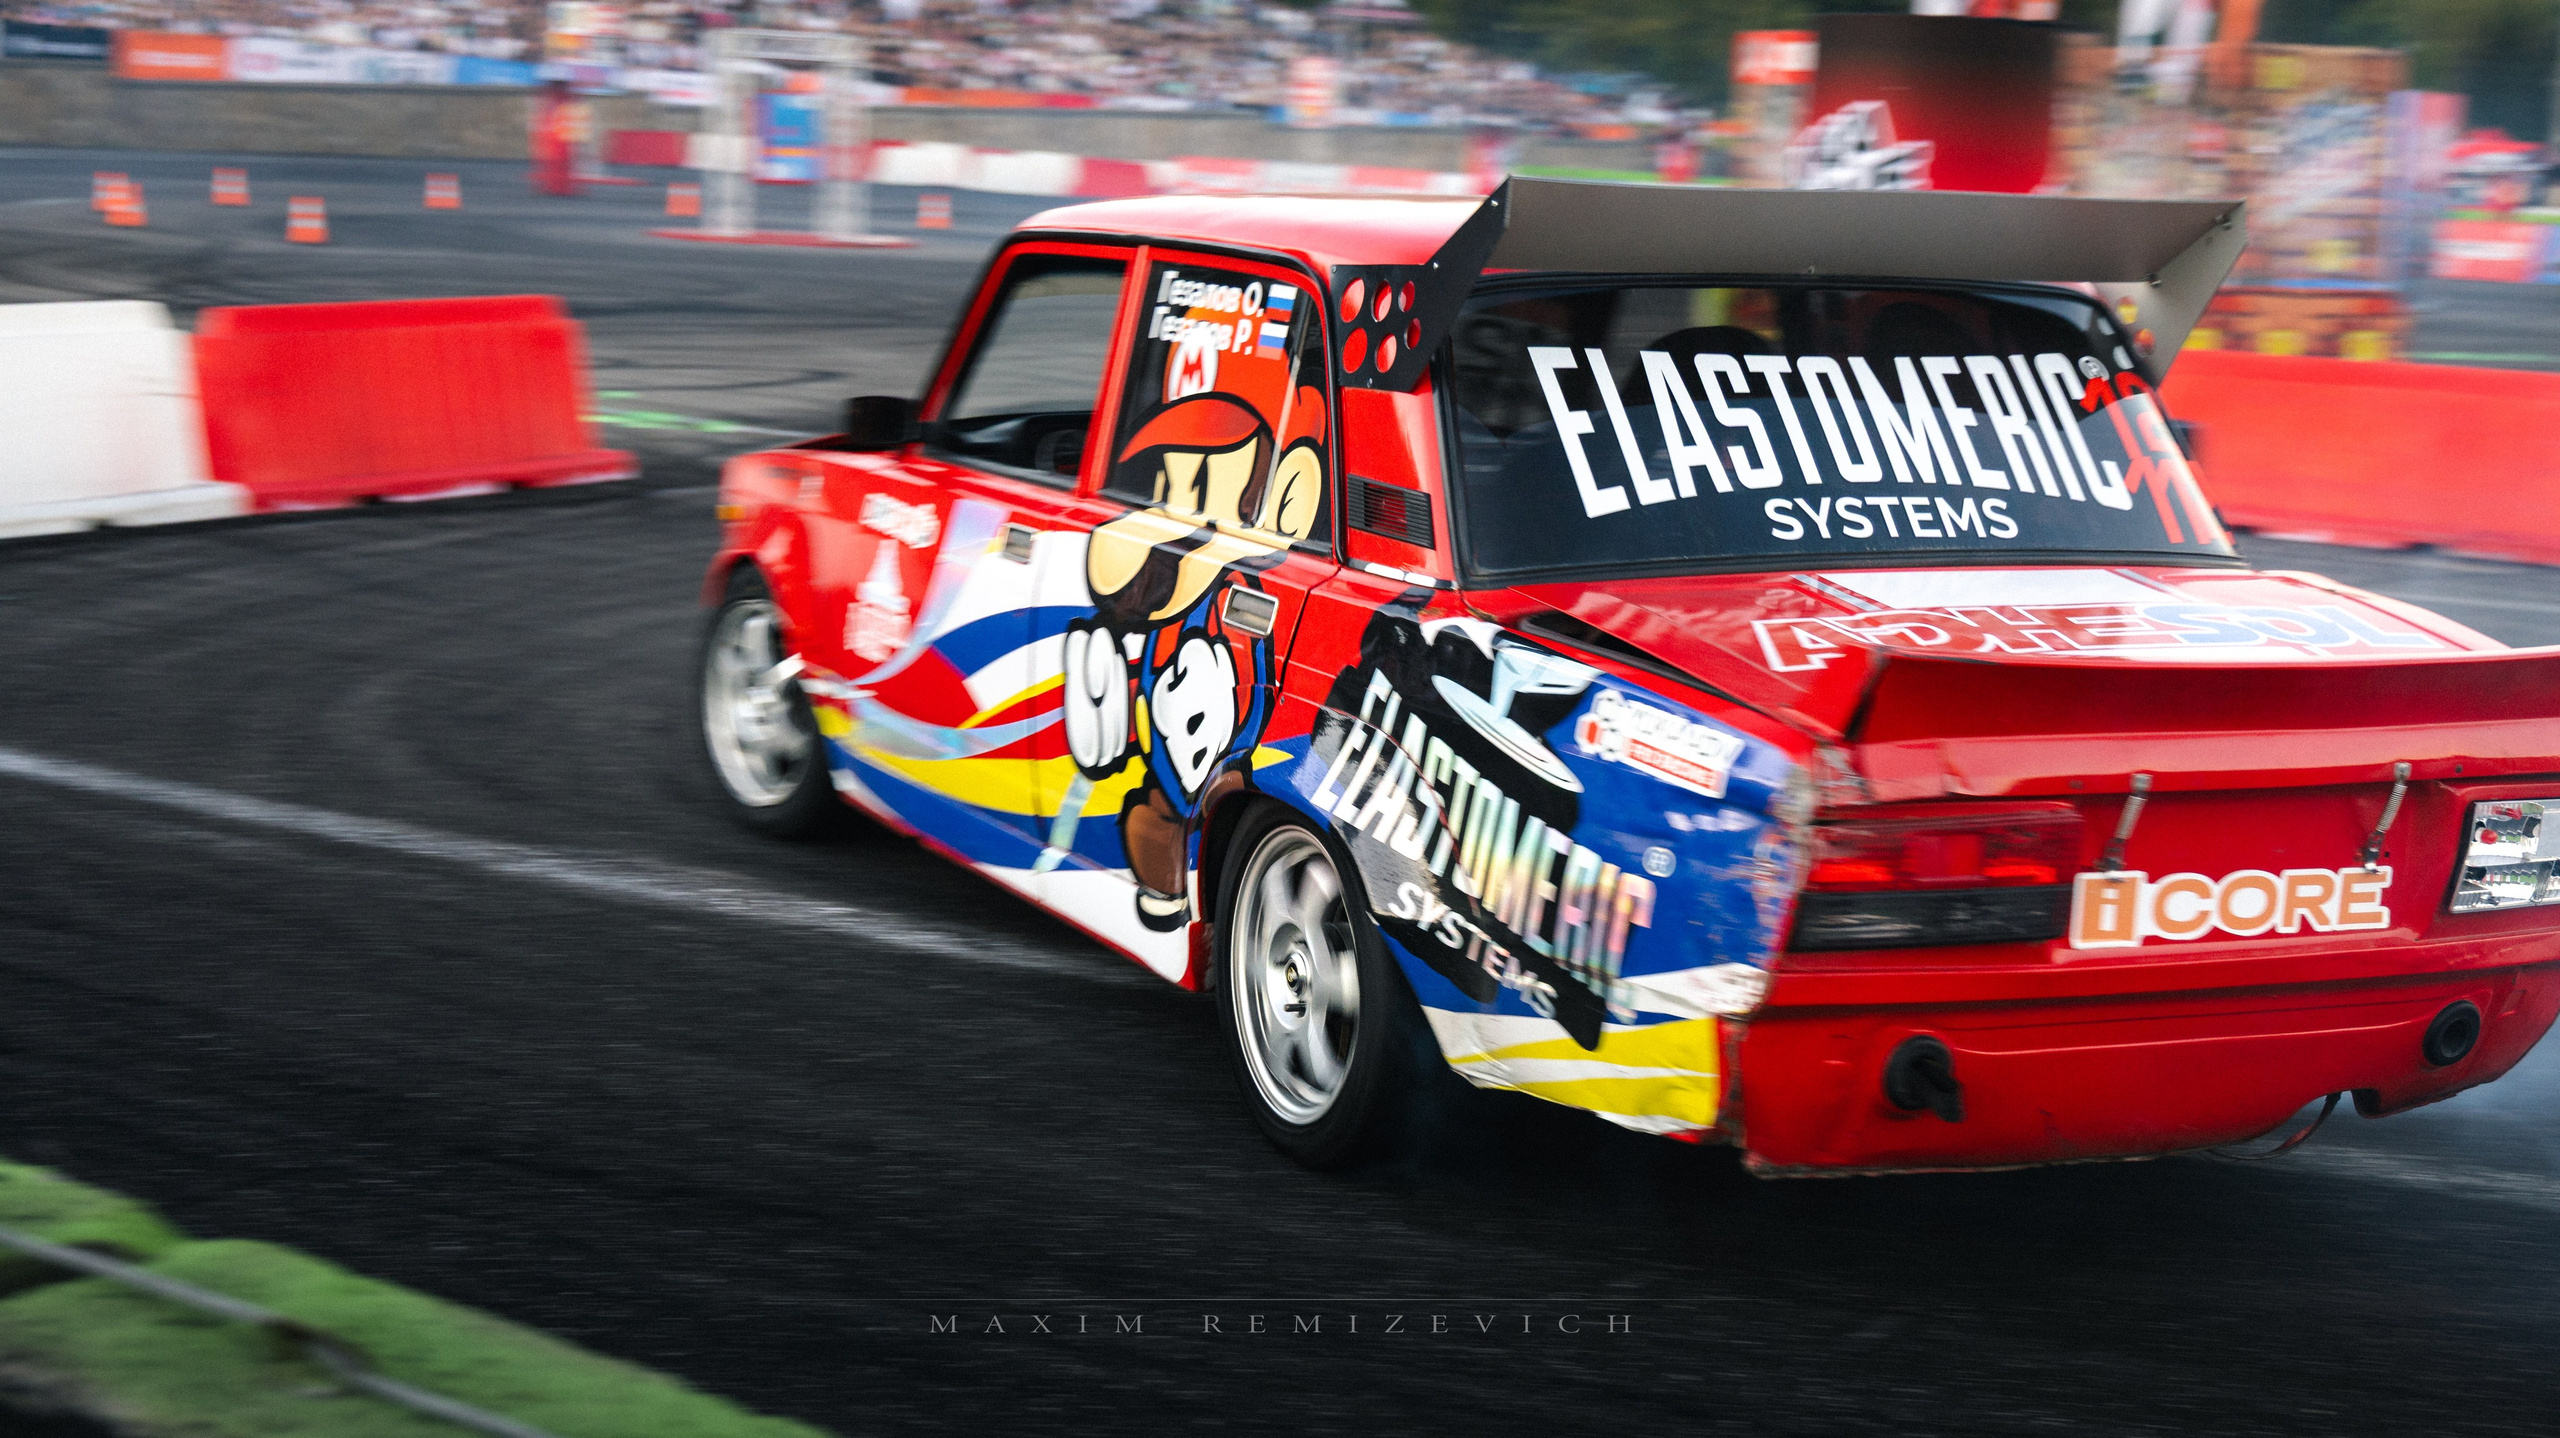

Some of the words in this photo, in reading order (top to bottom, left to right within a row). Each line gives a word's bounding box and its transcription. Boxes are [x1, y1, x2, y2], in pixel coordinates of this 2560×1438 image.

[1233, 319, 1253, 355] Р.
[1526, 346, 2133, 518] ELASTOMERIC
[1765, 496, 2019, 541] SYSTEMS
[1309, 667, 1658, 1025] ELASTOMERIC
[1387, 881, 1558, 1019] SYSTEMS
